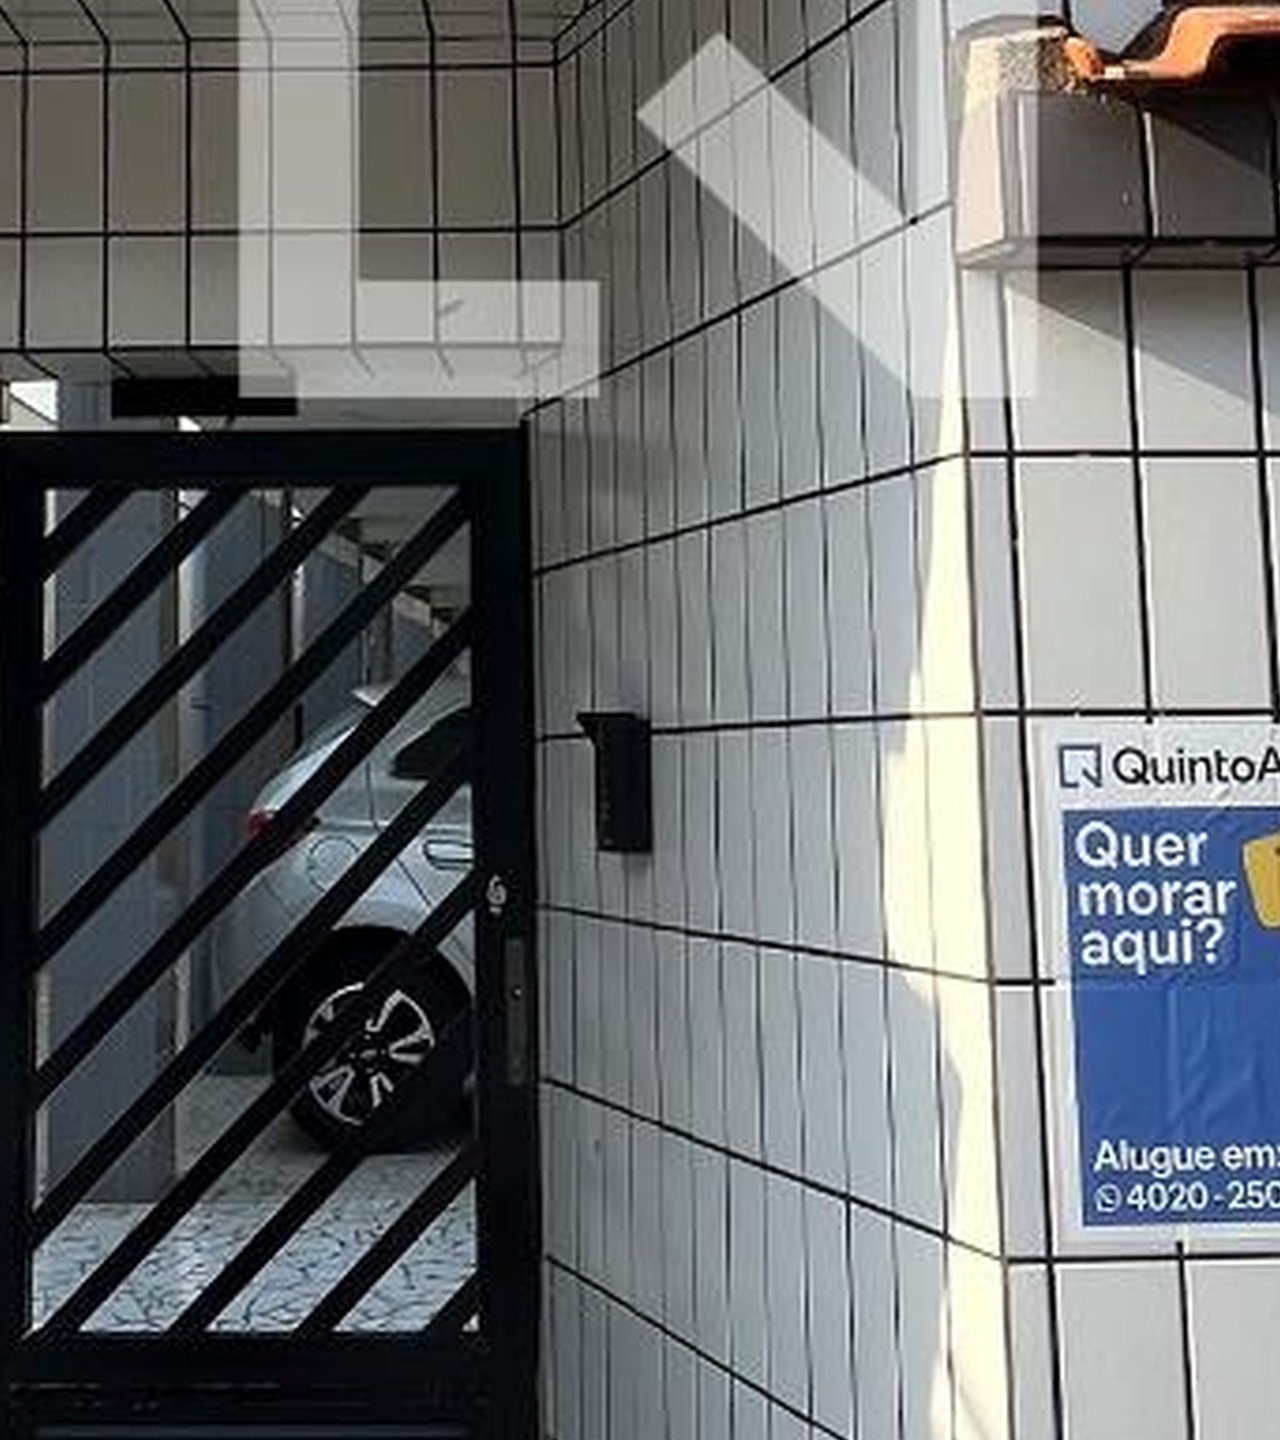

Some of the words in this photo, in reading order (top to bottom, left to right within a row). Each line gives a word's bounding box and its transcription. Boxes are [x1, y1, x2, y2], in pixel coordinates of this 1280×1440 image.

[1075, 821, 1208, 870] Quer
[1078, 879, 1236, 917] morar
[1081, 918, 1223, 976] aqui?
[1094, 1139, 1216, 1178] Alugue
